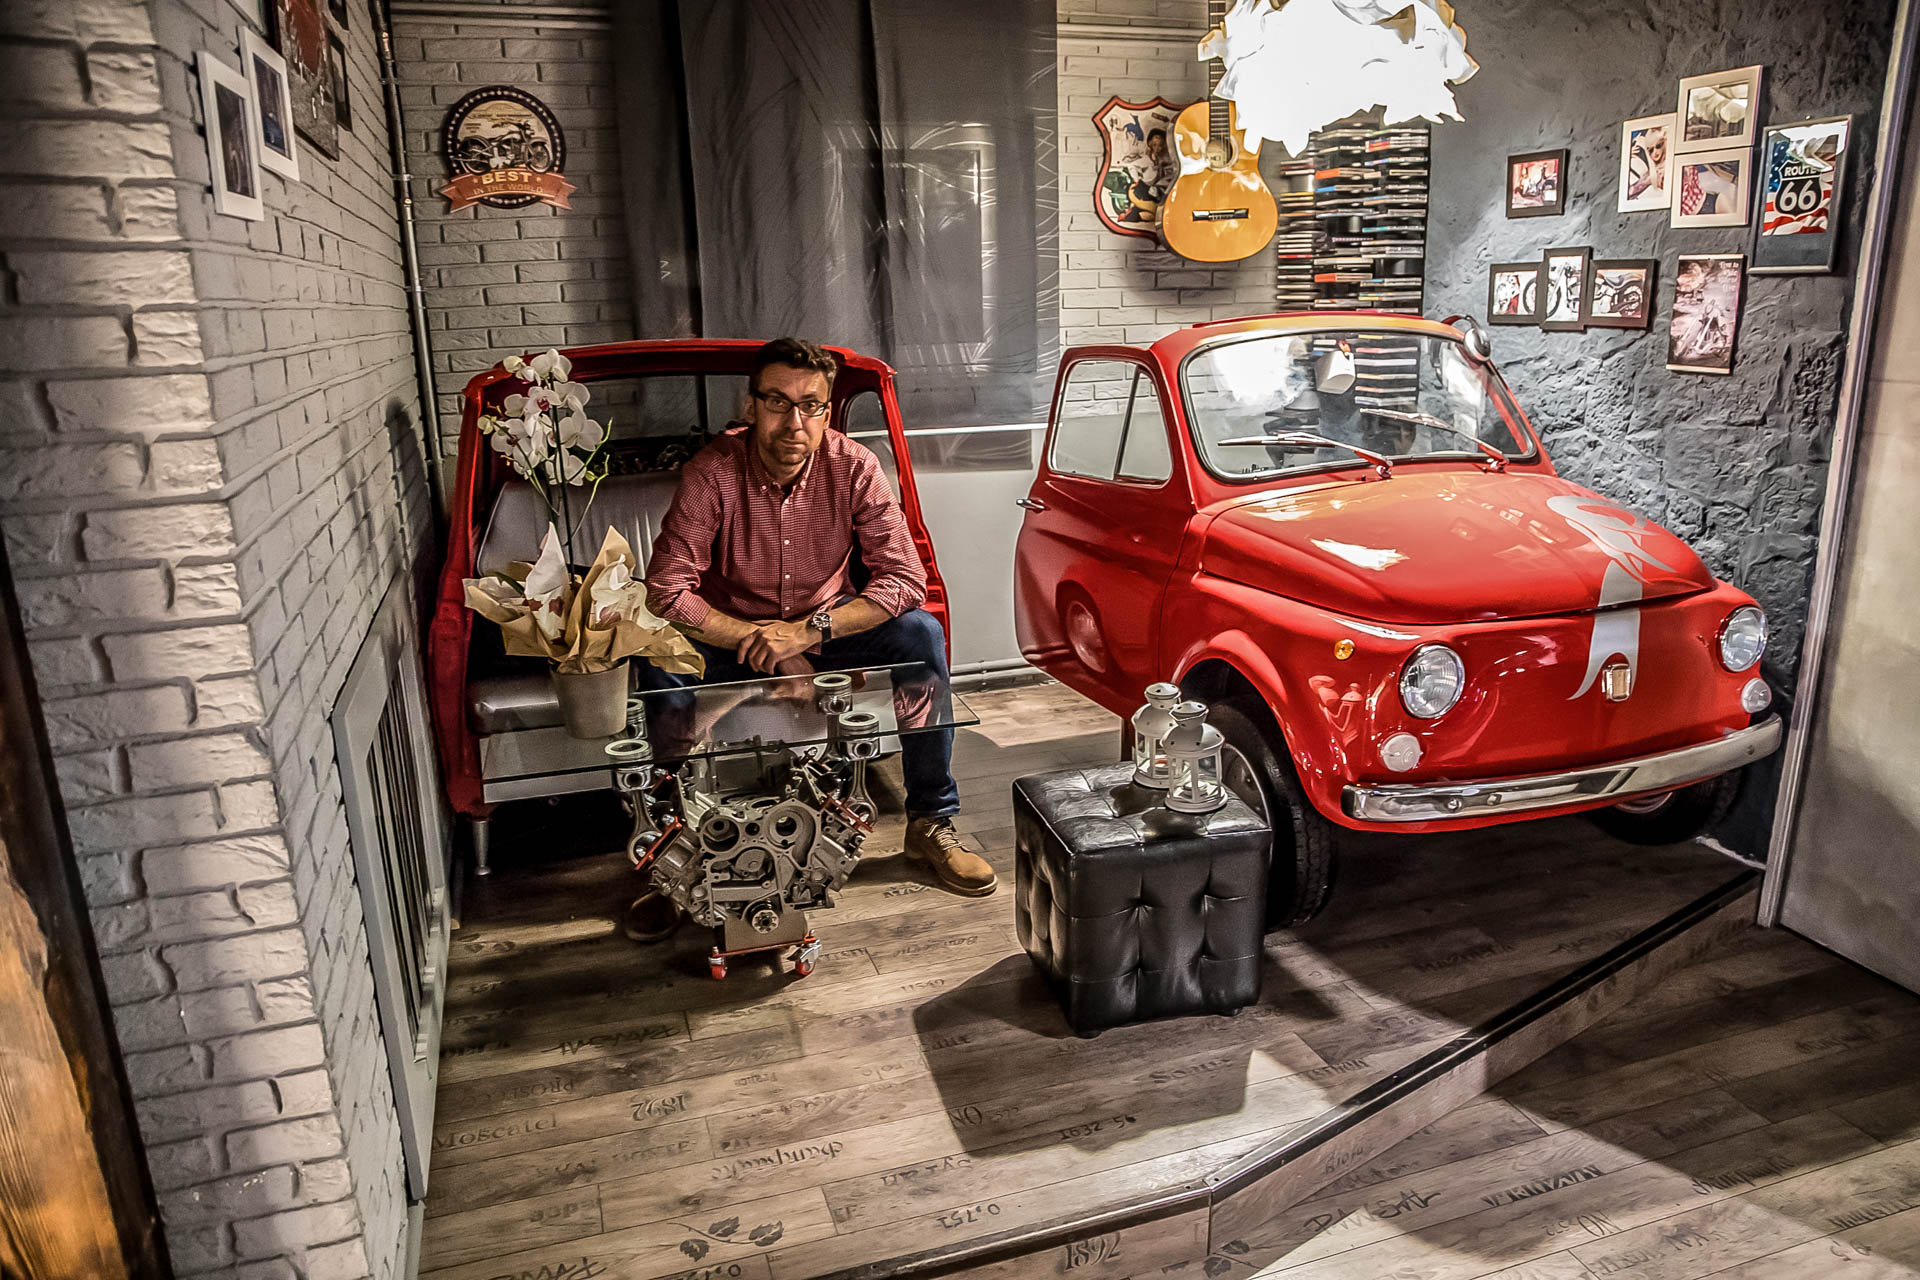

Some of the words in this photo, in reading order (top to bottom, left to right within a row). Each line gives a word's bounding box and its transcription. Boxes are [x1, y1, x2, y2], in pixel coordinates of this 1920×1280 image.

[482, 171, 532, 185] BEST
[1784, 165, 1818, 177] ROUTE
[487, 185, 505, 193] THE
[508, 184, 544, 193] WORLD
[1780, 179, 1817, 212] 66
[631, 1095, 687, 1122] 1892
[1063, 1232, 1122, 1270] 1892
